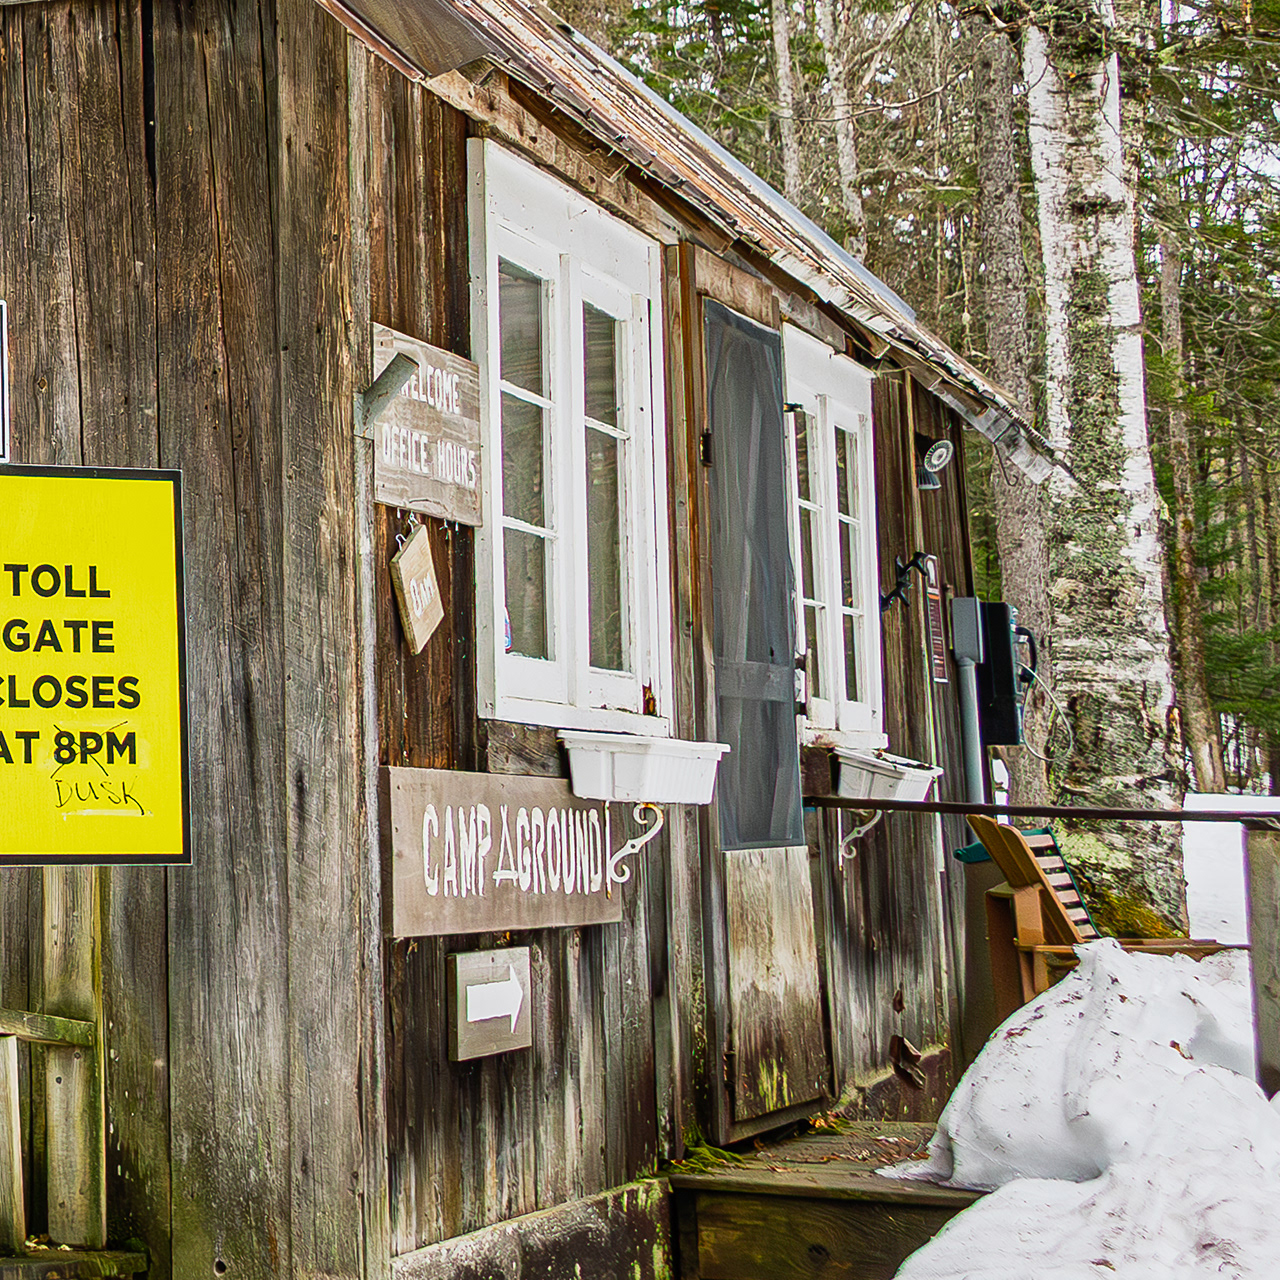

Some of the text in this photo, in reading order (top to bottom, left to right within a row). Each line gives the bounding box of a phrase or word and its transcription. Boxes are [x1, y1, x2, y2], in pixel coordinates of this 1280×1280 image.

[382, 423, 476, 489] OFFICE HOURS
[3, 563, 111, 598] TOLL
[2, 619, 115, 653] GATE
[53, 730, 136, 765] 8PM
[54, 776, 144, 816] DUSK
[422, 803, 603, 898] CAMP GROUND
